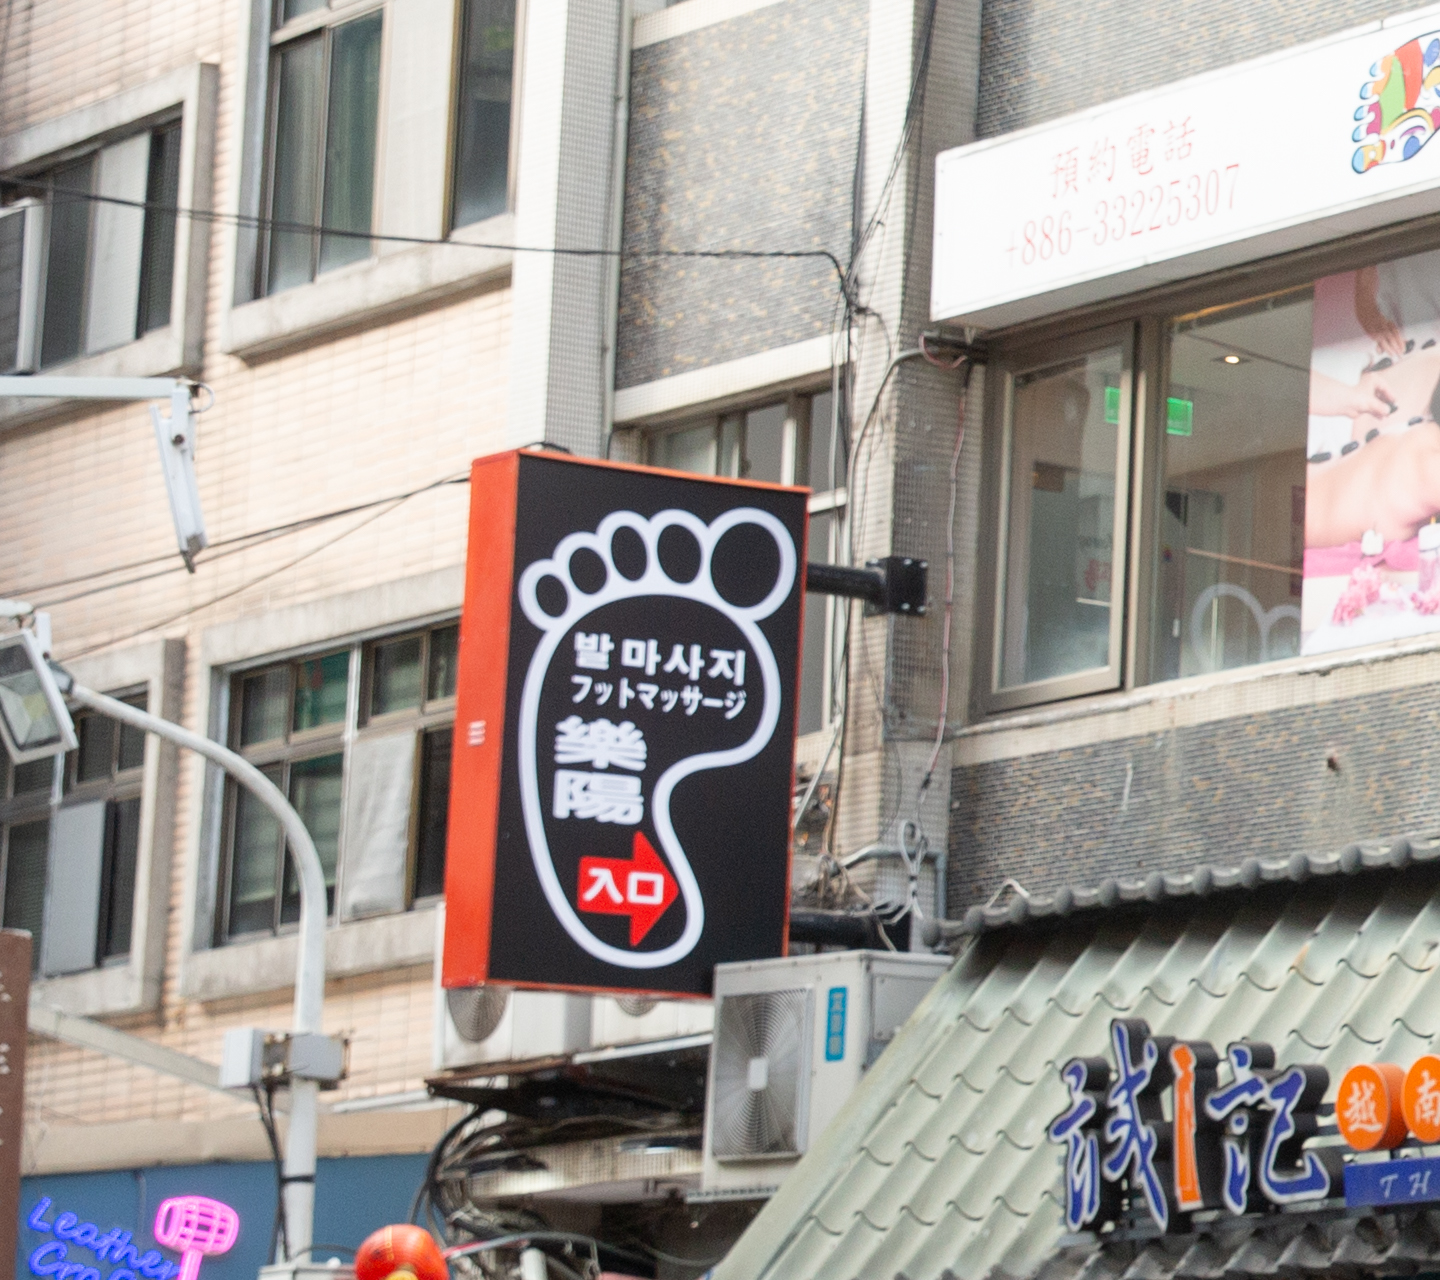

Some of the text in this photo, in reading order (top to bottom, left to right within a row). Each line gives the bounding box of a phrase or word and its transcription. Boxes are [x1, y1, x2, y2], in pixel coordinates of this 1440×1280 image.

[1046, 116, 1196, 199] 預約電話
[1003, 163, 1242, 273] +886-33225307
[573, 631, 747, 686] 발 마사지
[570, 674, 747, 720] フットマッサージ
[553, 716, 647, 826] 樂陽
[582, 867, 665, 907] 入口
